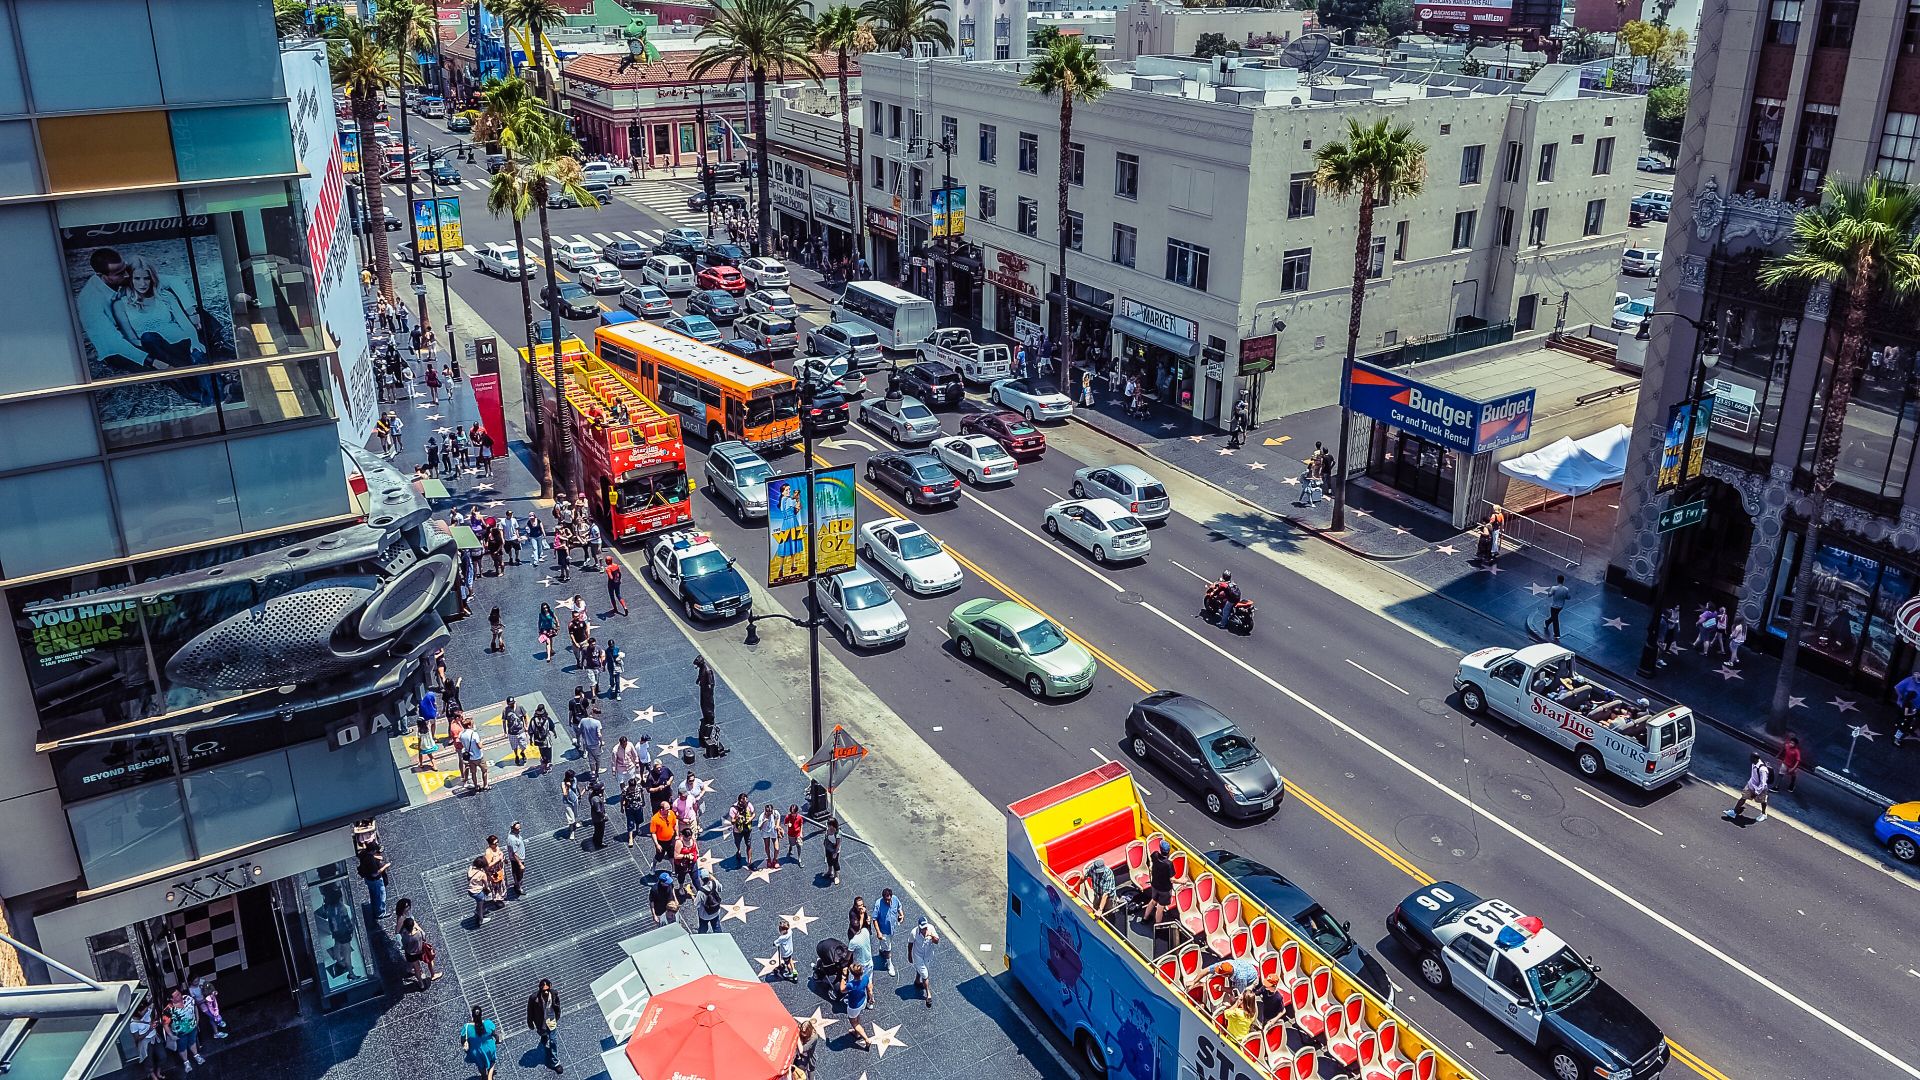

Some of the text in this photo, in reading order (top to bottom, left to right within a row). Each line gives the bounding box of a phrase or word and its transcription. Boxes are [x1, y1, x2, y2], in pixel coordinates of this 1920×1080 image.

[87, 214, 208, 237] Diamons
[1407, 387, 1474, 429] Budget
[1480, 395, 1532, 425] Budget
[681, 416, 701, 435] Local
[1391, 408, 1470, 447] Car and Truck Rental
[1477, 431, 1526, 452] Car and Truck Rental
[772, 525, 808, 545] WIZ
[817, 518, 855, 537] ARD
[820, 533, 854, 554] OZ
[29, 606, 75, 629] YOU
[79, 599, 138, 619] HAVE
[32, 601, 177, 643] KNOW YOUR
[1604, 735, 1646, 764] TOURS
[82, 755, 171, 785] BEYOND REASON
[172, 862, 256, 907] XXI
[1195, 1035, 1253, 1080] ST
